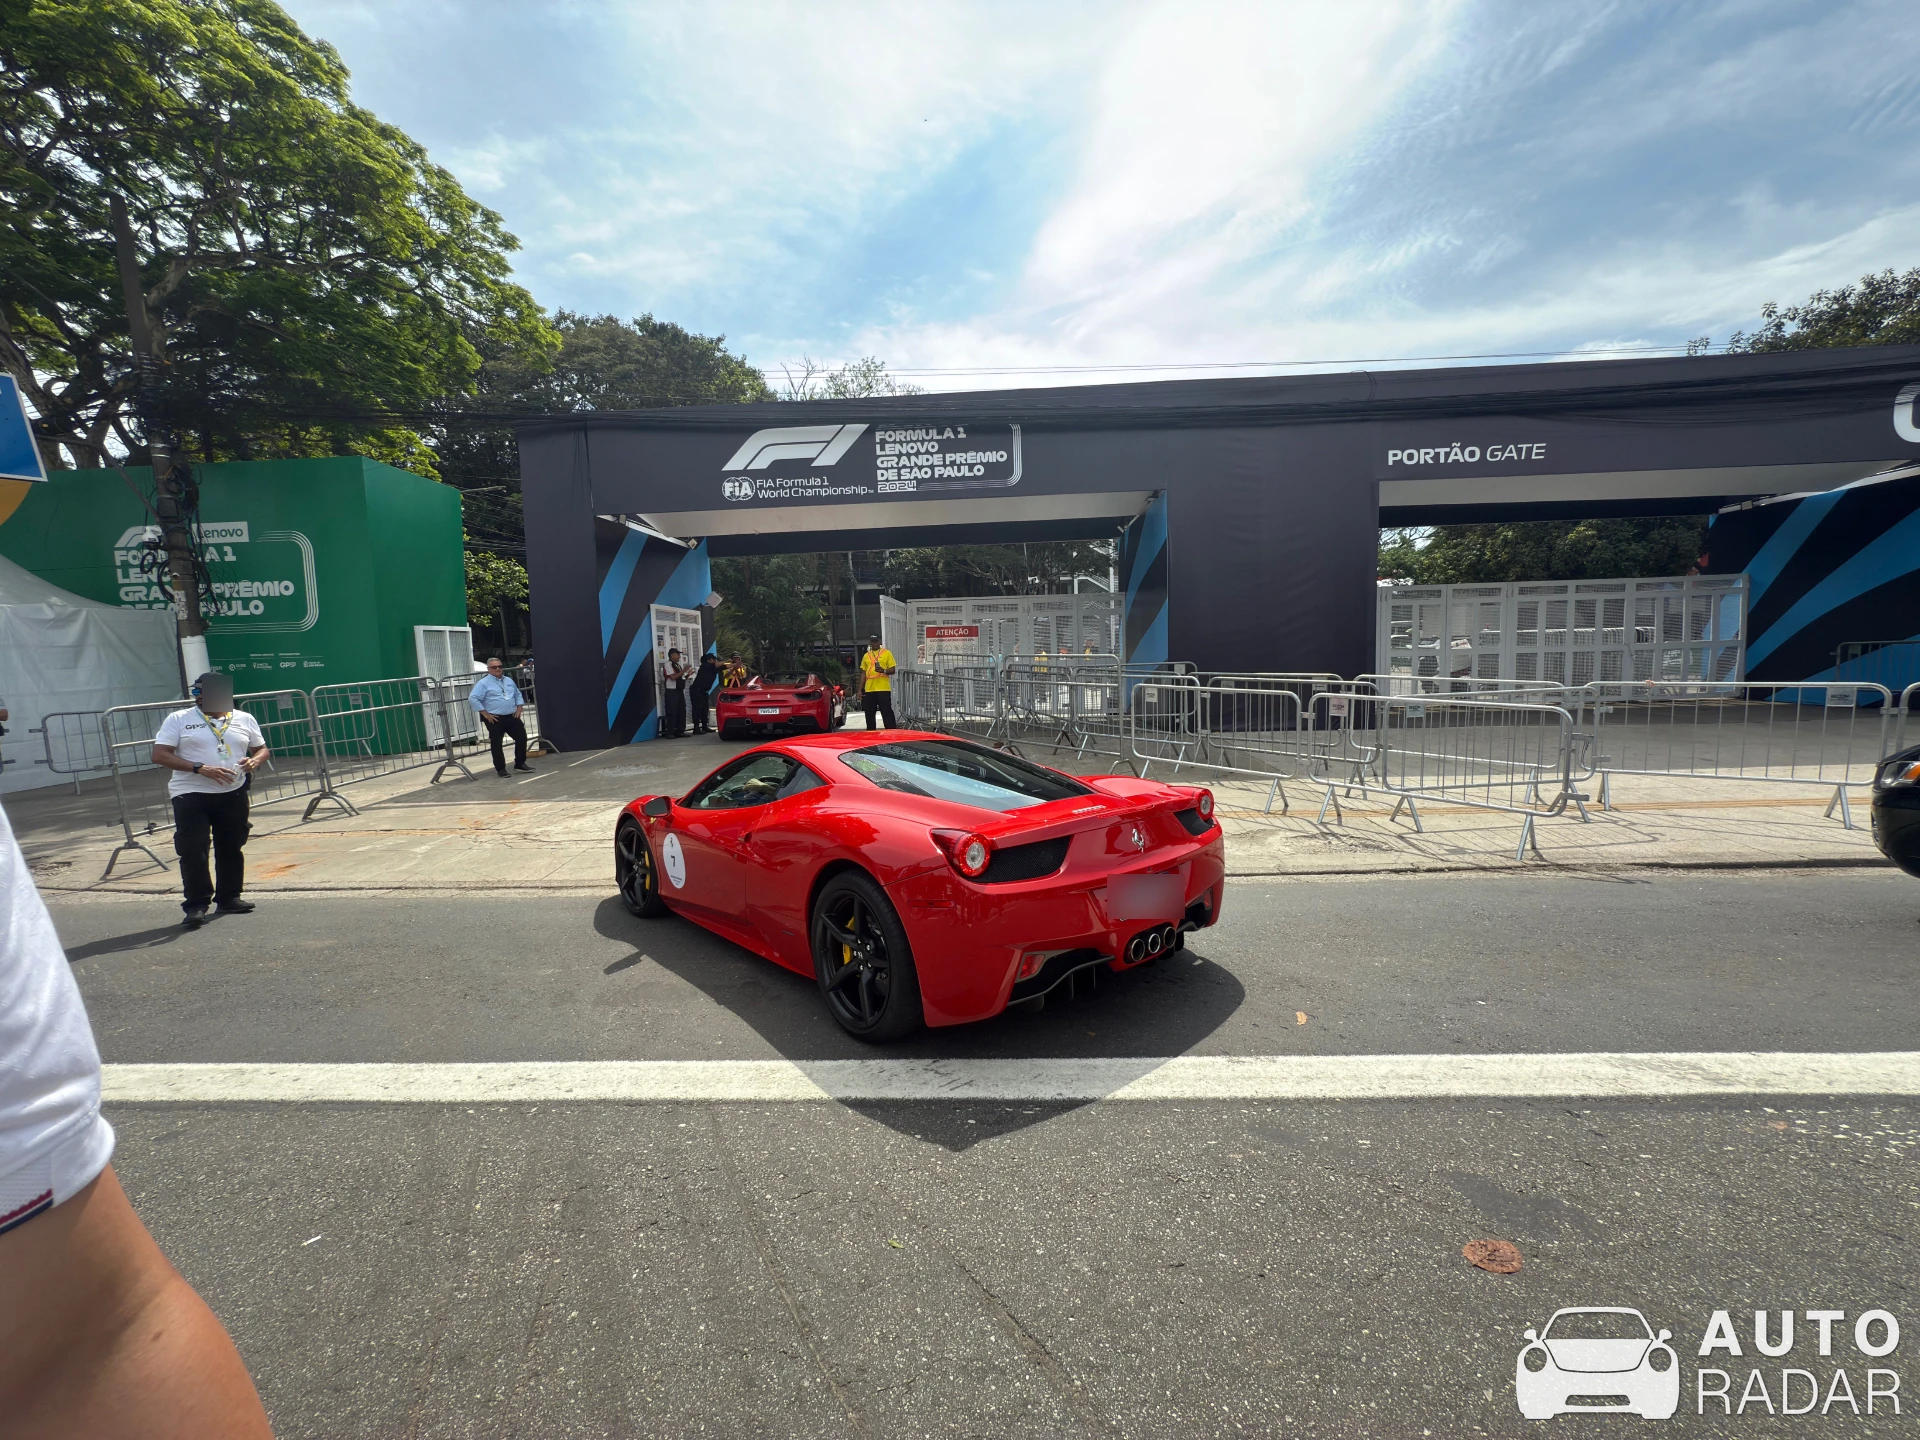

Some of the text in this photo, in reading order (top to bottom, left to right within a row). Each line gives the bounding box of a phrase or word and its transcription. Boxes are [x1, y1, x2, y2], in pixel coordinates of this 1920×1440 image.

[875, 428, 955, 443] FORMULA
[876, 441, 939, 456] LENOVO
[1388, 442, 1547, 466] PORTÃO GATE
[876, 450, 1008, 468] GRANDE PRÊMIO
[877, 464, 985, 481] DE SÃO PAULO
[756, 476, 829, 488] FIA Formula 1
[878, 481, 917, 493] 2024
[757, 487, 790, 499] World
[223, 545, 237, 562] 1
[936, 628, 969, 637] ATENÇÃO
[670, 855, 676, 867] 7
